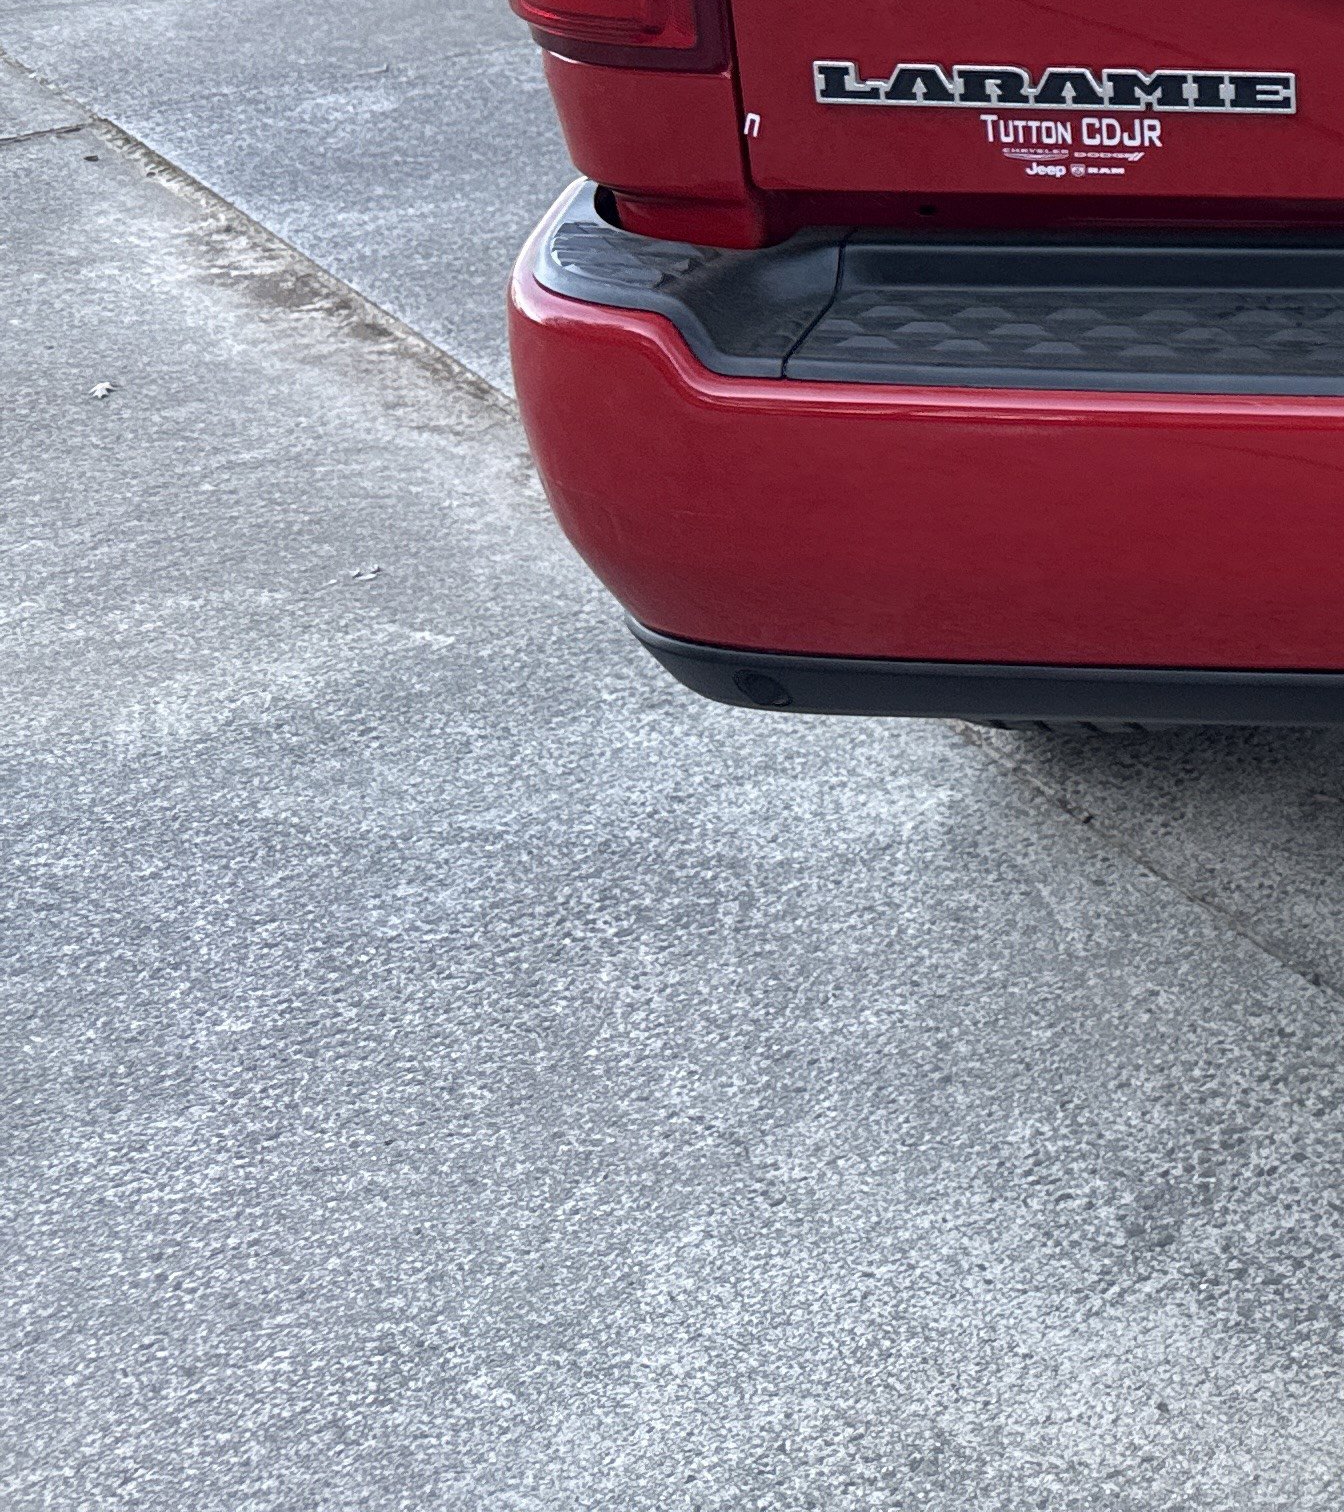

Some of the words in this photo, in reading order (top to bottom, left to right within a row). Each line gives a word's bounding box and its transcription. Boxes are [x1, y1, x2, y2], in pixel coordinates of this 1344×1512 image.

[813, 60, 1297, 115] LARAMIE
[980, 114, 1072, 145] TUTTON
[1081, 117, 1163, 147] CDJR
[1025, 162, 1067, 178] Jeep
